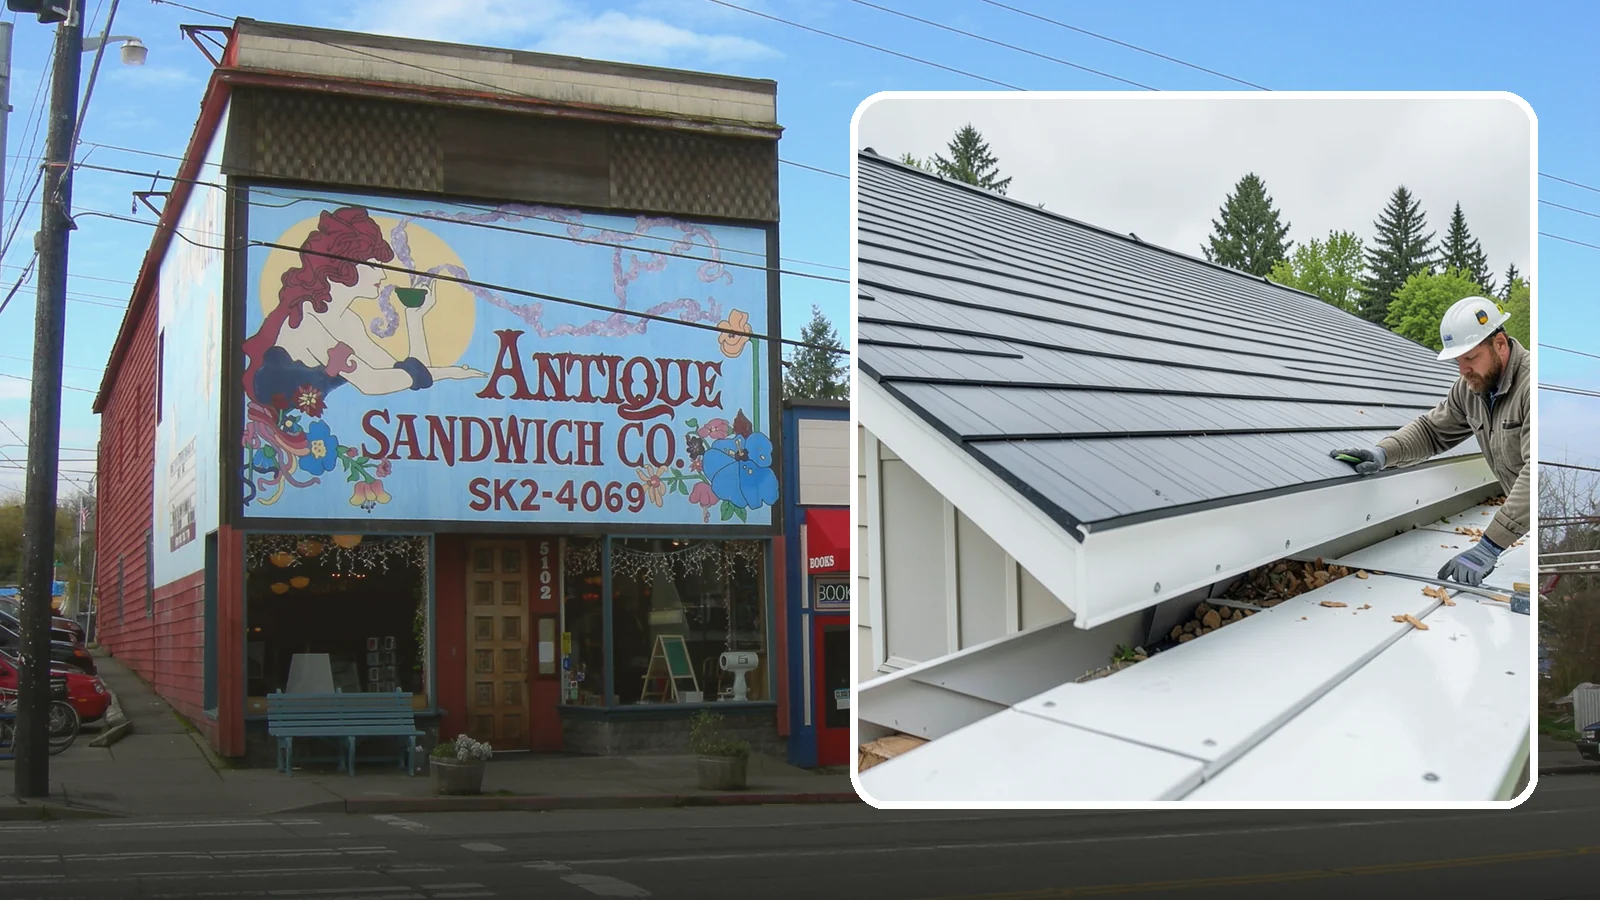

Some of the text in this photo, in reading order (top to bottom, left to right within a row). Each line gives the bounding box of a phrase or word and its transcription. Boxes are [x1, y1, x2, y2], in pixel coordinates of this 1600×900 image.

[476, 329, 724, 420] ANTIQUE
[362, 408, 685, 468] SANDWICH CO.
[468, 477, 646, 512] SK2-4069
[540, 541, 551, 600] 5102
[809, 555, 835, 569] BOOKS
